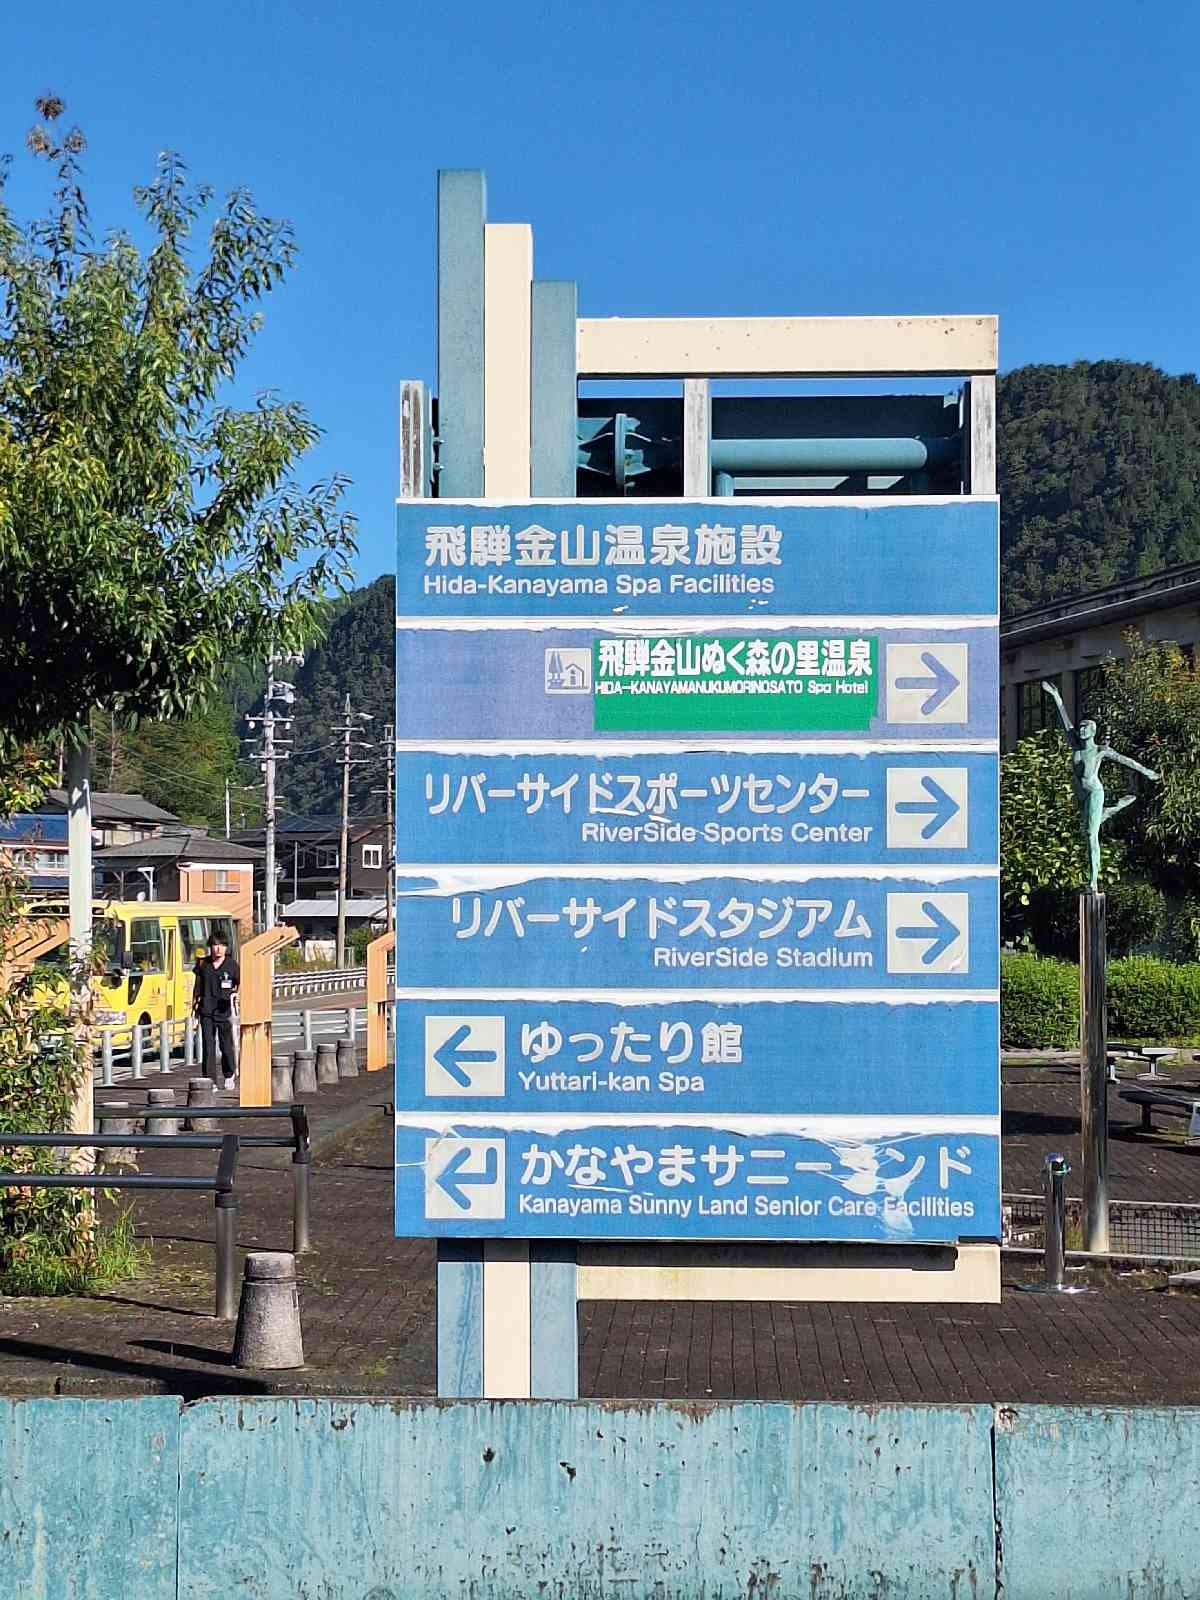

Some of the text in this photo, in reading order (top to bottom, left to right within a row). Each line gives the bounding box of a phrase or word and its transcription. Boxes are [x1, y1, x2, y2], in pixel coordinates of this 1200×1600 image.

[425, 524, 783, 566] 飛騨金山温泉施設
[424, 574, 775, 596] Hida-Kanayama Spa Facilities
[598, 639, 873, 677] 飛騨金山ぬく森の里温泉
[808, 680, 831, 695] Spa
[836, 680, 868, 694] Hotel
[425, 773, 870, 815] リバーサイドスポーツセンター
[582, 823, 873, 845] RiverSide Sports Center
[452, 898, 872, 939] リバーサイドスタジアム
[654, 947, 873, 967] RiverSide Stadium
[521, 1022, 743, 1064] ゆったり館
[518, 1071, 705, 1095] Yuttari-kan Spa
[520, 1145, 972, 1189] かなやまサニーンド
[519, 1195, 975, 1218] Kanayama Sunny Land Senior Care Facilities
